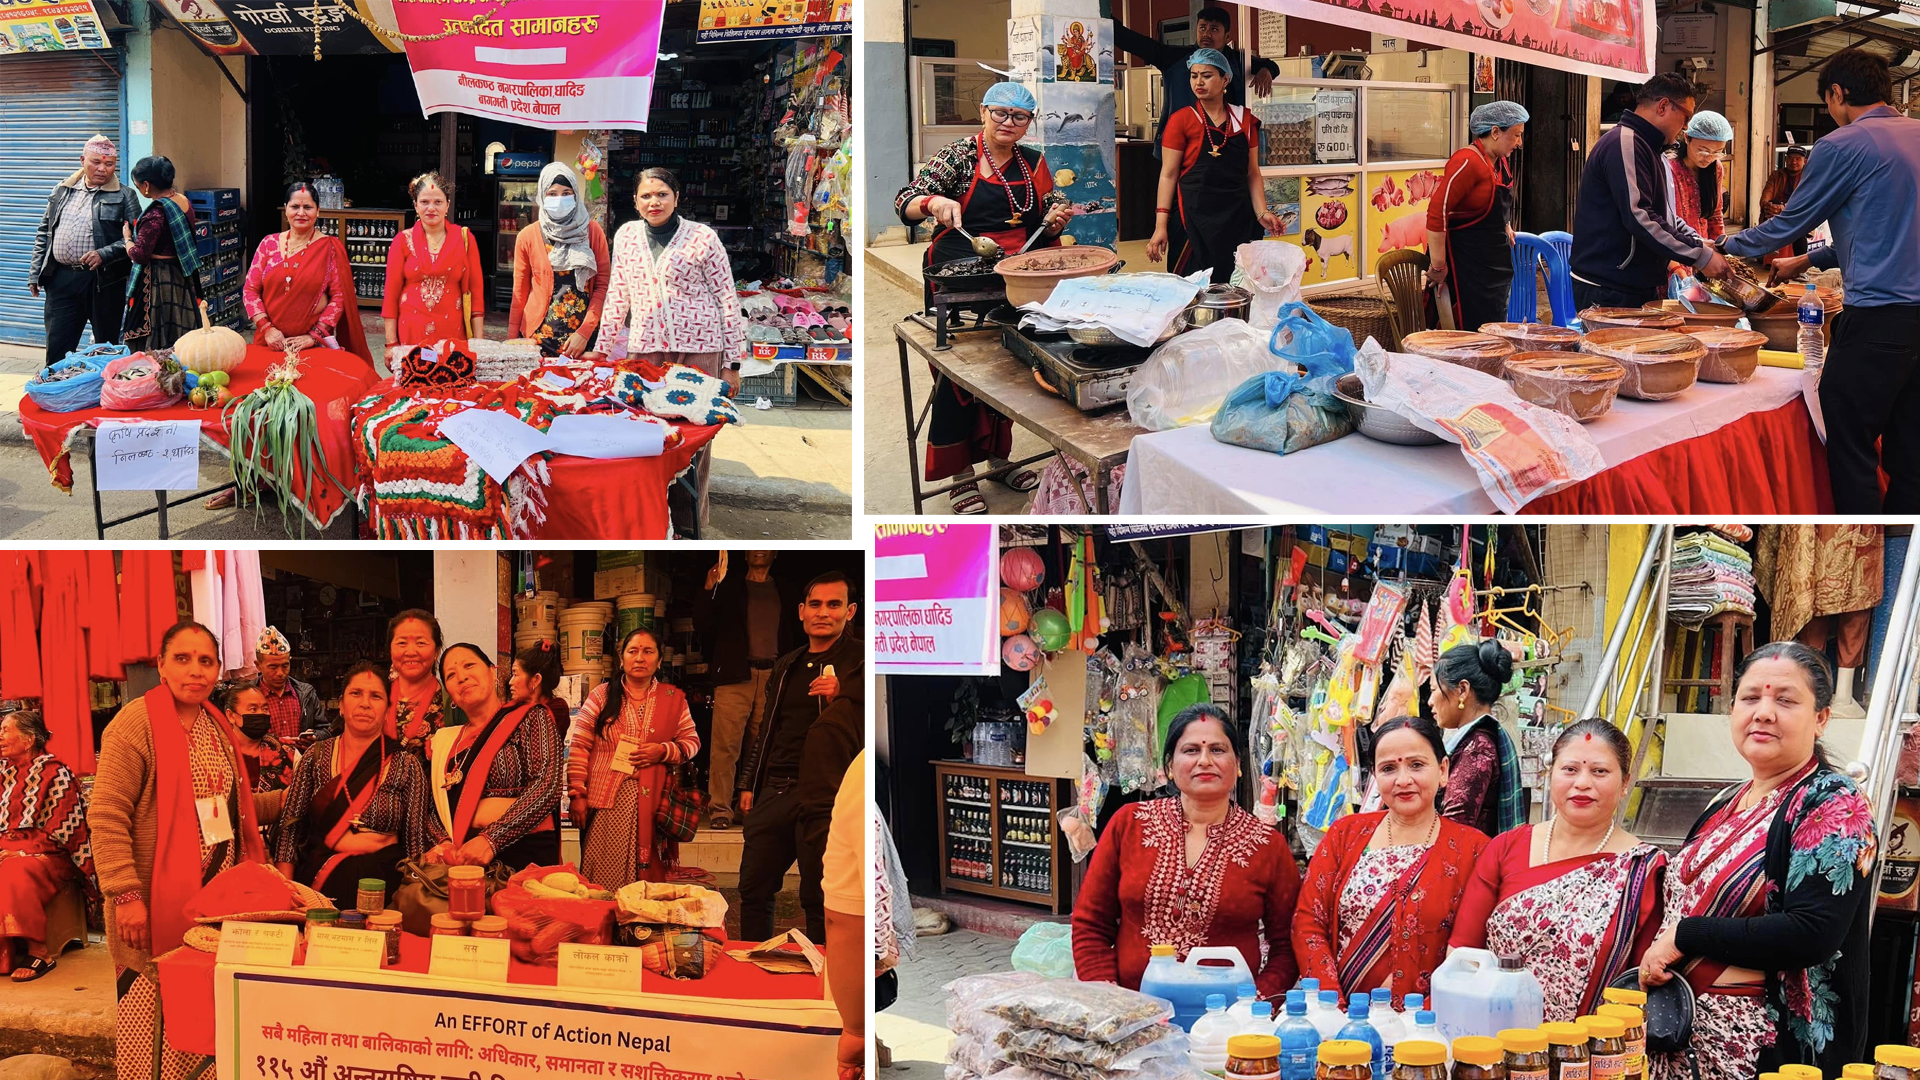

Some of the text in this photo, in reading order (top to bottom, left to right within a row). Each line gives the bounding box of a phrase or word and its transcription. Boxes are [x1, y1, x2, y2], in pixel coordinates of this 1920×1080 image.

[233, 2, 293, 25] गोर्खा
[264, 26, 302, 34] GORKHA
[458, 74, 495, 92] नीलकण्ठ
[478, 94, 509, 110] बागमती
[514, 160, 541, 169] pepsi
[223, 208, 237, 216] PEPSI
[225, 237, 238, 246] PEPSI
[758, 348, 771, 356] RK
[811, 352, 827, 360] RK
[463, 944, 479, 954] सस
[573, 949, 600, 962] लोकल
[435, 1012, 671, 1054] An EFFORT of Action Nepal
[261, 1022, 284, 1040] सबै
[287, 1024, 328, 1047] महिला
[331, 1032, 359, 1049] तथा
[362, 1032, 433, 1056] बालिकाको
[435, 1038, 473, 1060] लागि:
[545, 1055, 605, 1076] समानता
[608, 1062, 618, 1077] र
[256, 1055, 294, 1080] ११५
